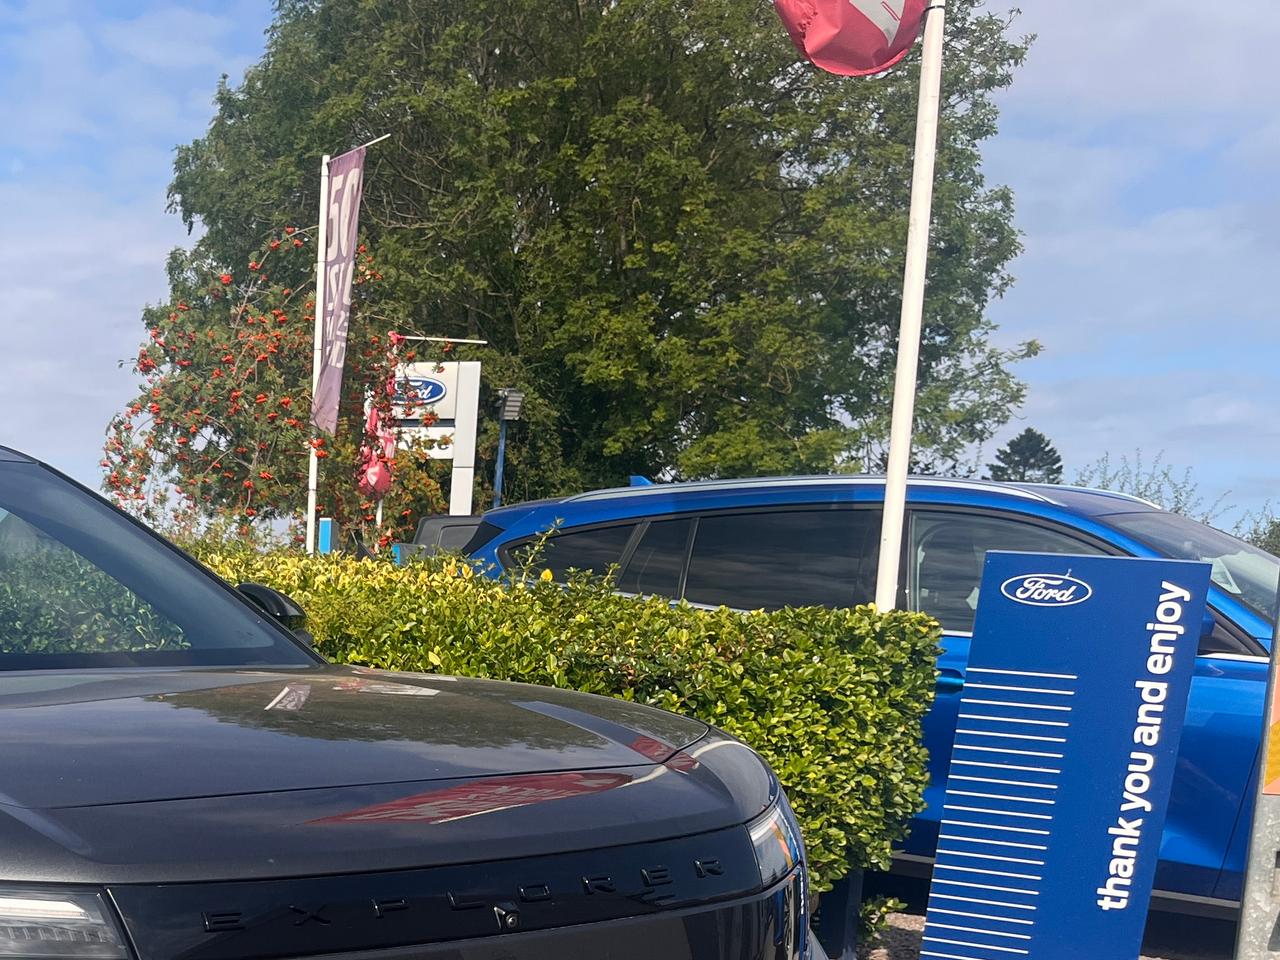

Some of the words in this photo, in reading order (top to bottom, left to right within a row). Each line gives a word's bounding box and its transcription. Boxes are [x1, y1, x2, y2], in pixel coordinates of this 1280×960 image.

[1016, 575, 1074, 603] Ford
[1146, 580, 1192, 675] enjoy
[1133, 680, 1168, 748] and
[1120, 750, 1155, 813] you
[201, 859, 724, 933] EXPLORER
[1096, 816, 1144, 911] thank
